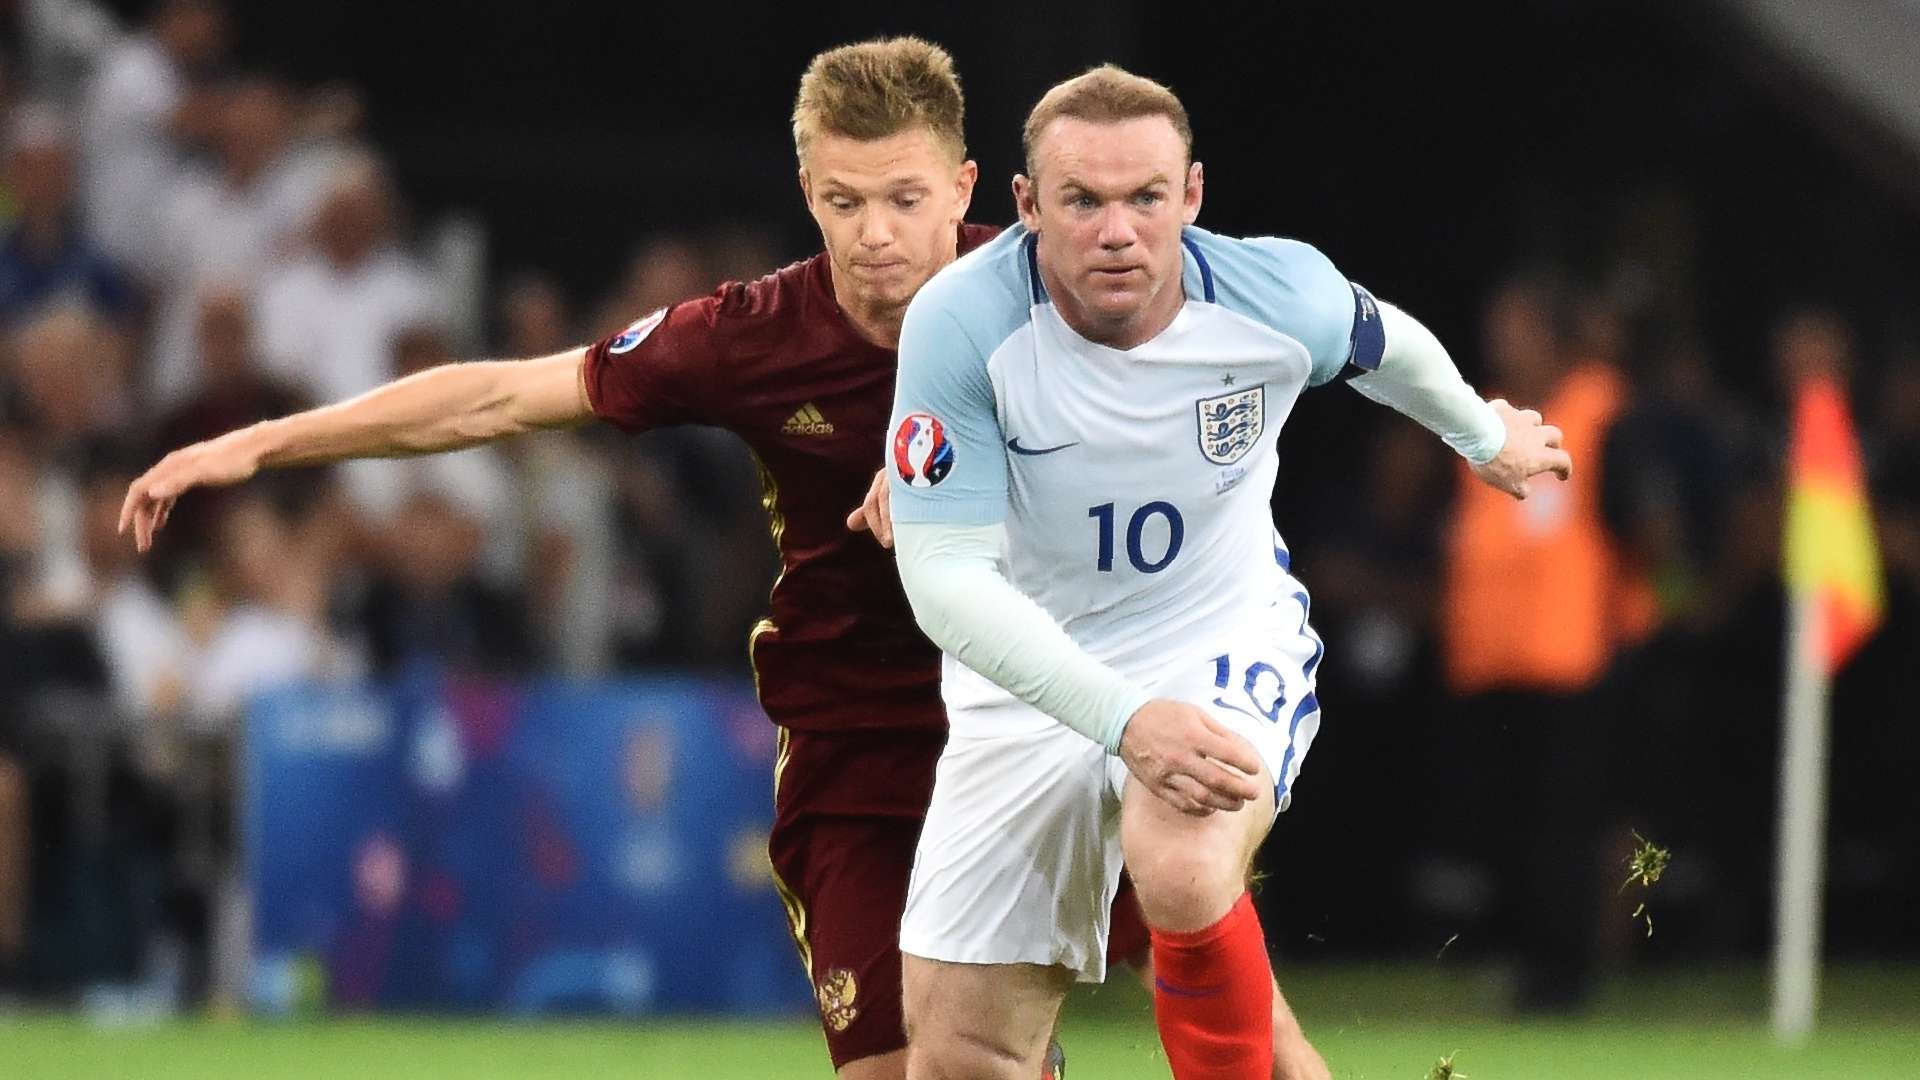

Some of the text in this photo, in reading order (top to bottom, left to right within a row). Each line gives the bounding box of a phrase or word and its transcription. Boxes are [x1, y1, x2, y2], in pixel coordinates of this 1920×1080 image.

[781, 422, 834, 435] adidas
[1088, 501, 1184, 573] 10
[1210, 654, 1287, 722] 10
